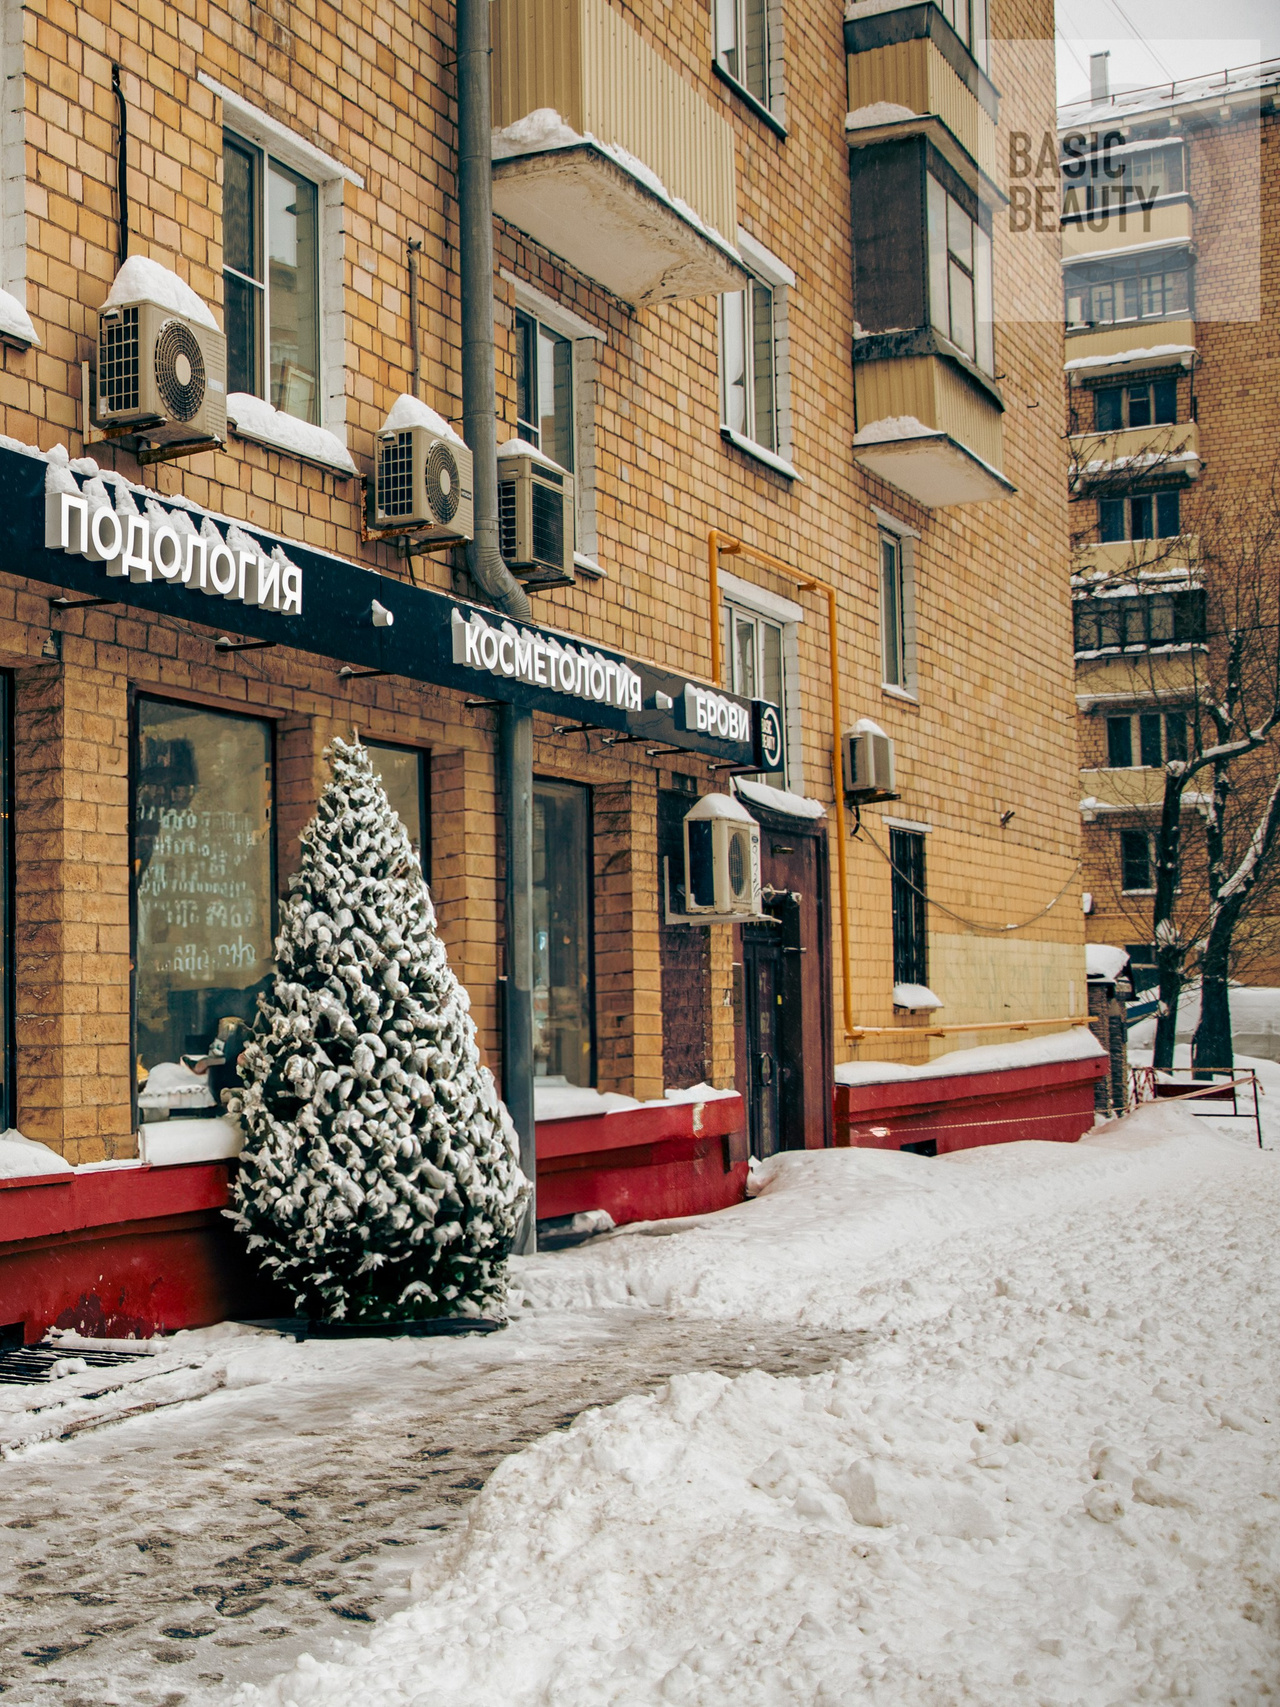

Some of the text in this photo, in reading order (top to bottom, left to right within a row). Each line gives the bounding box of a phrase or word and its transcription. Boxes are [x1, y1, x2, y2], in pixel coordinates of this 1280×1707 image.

[60, 492, 302, 614] ПОДОЛОГИЯ
[464, 622, 642, 711] КОСМЕТОЛОГИЯ
[696, 696, 750, 742] БРОВИ
